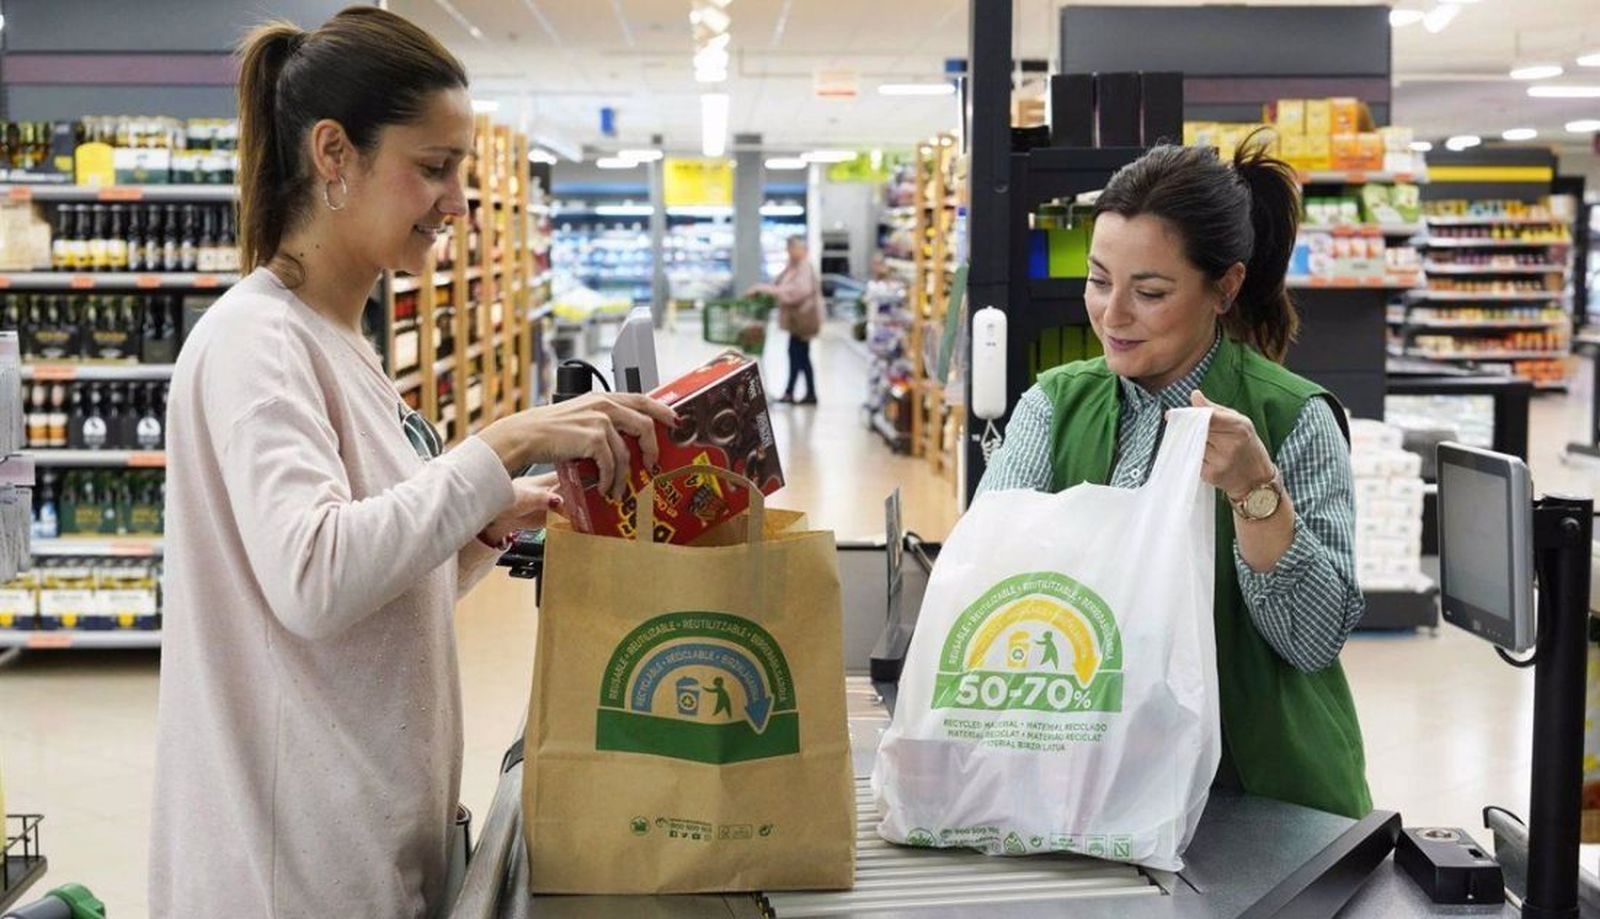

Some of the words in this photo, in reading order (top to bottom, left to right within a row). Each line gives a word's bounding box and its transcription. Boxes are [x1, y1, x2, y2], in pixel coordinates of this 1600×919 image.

[608, 657, 628, 701] REUSABLE
[626, 621, 677, 655] REUTILIZABLE
[956, 673, 1092, 711] 50-70%
[943, 719, 983, 730] RECYCLED
[984, 720, 1018, 730] MATERIAL
[1026, 721, 1062, 732] MATERIAL
[1063, 722, 1108, 733] RECICLADO
[947, 730, 983, 740] MATERIAL
[1026, 732, 1063, 742] MATERIAL
